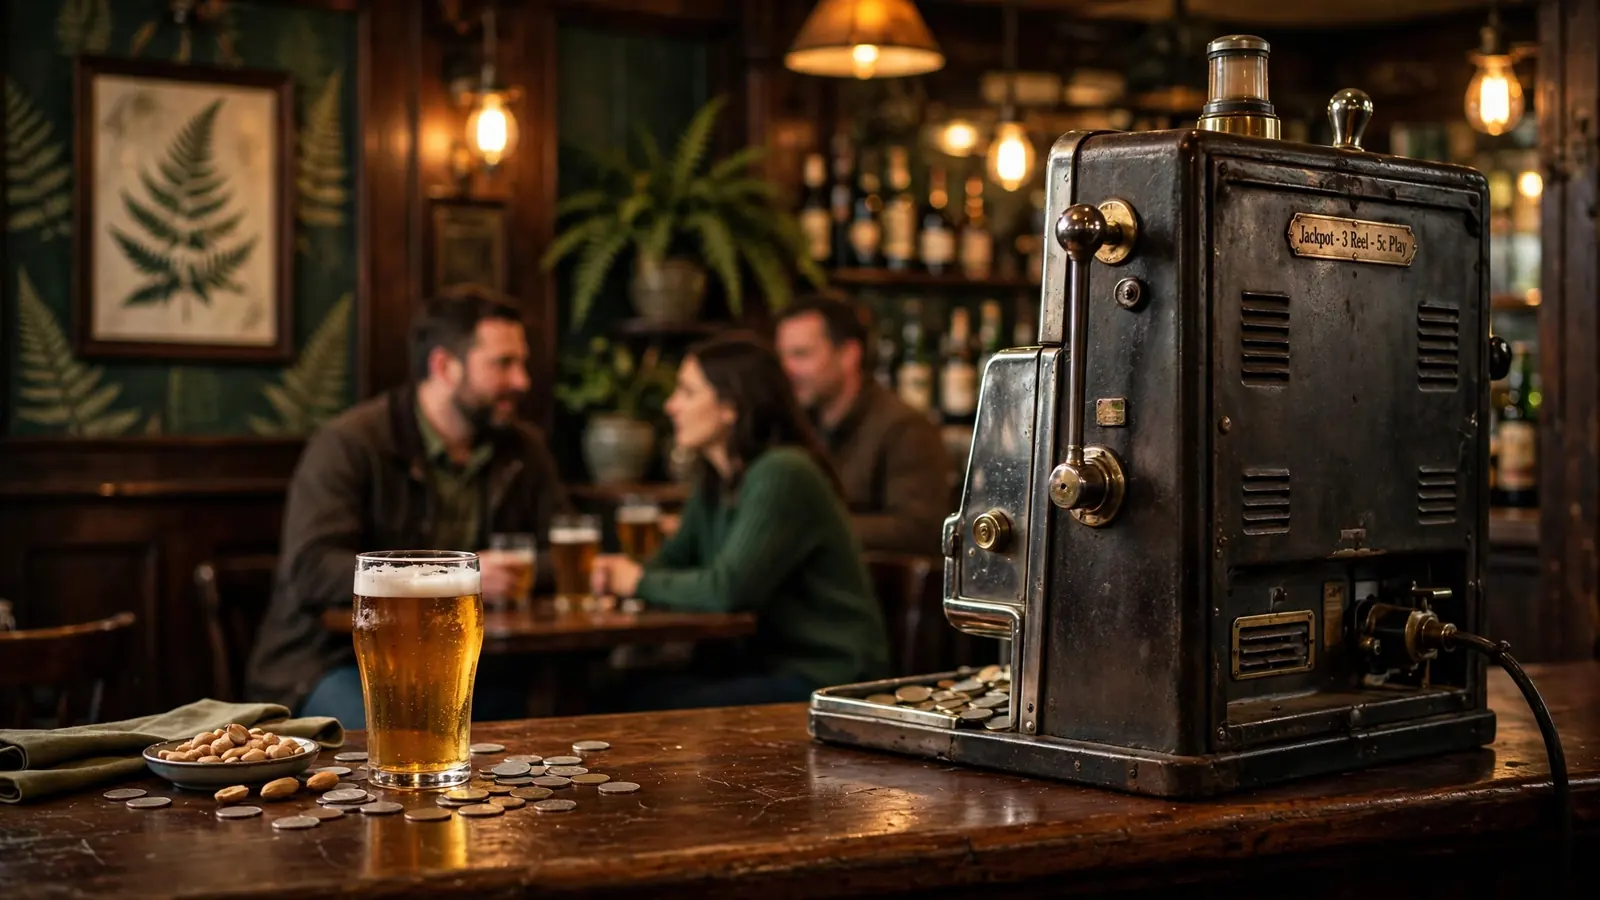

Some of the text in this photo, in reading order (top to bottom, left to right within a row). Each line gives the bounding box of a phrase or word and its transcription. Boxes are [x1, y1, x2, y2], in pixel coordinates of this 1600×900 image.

[1299, 225, 1334, 249] Jackpot
[1342, 230, 1348, 247] 3
[1350, 231, 1368, 249] Reel
[1377, 234, 1386, 252] 5c
[1389, 235, 1407, 257] Play
